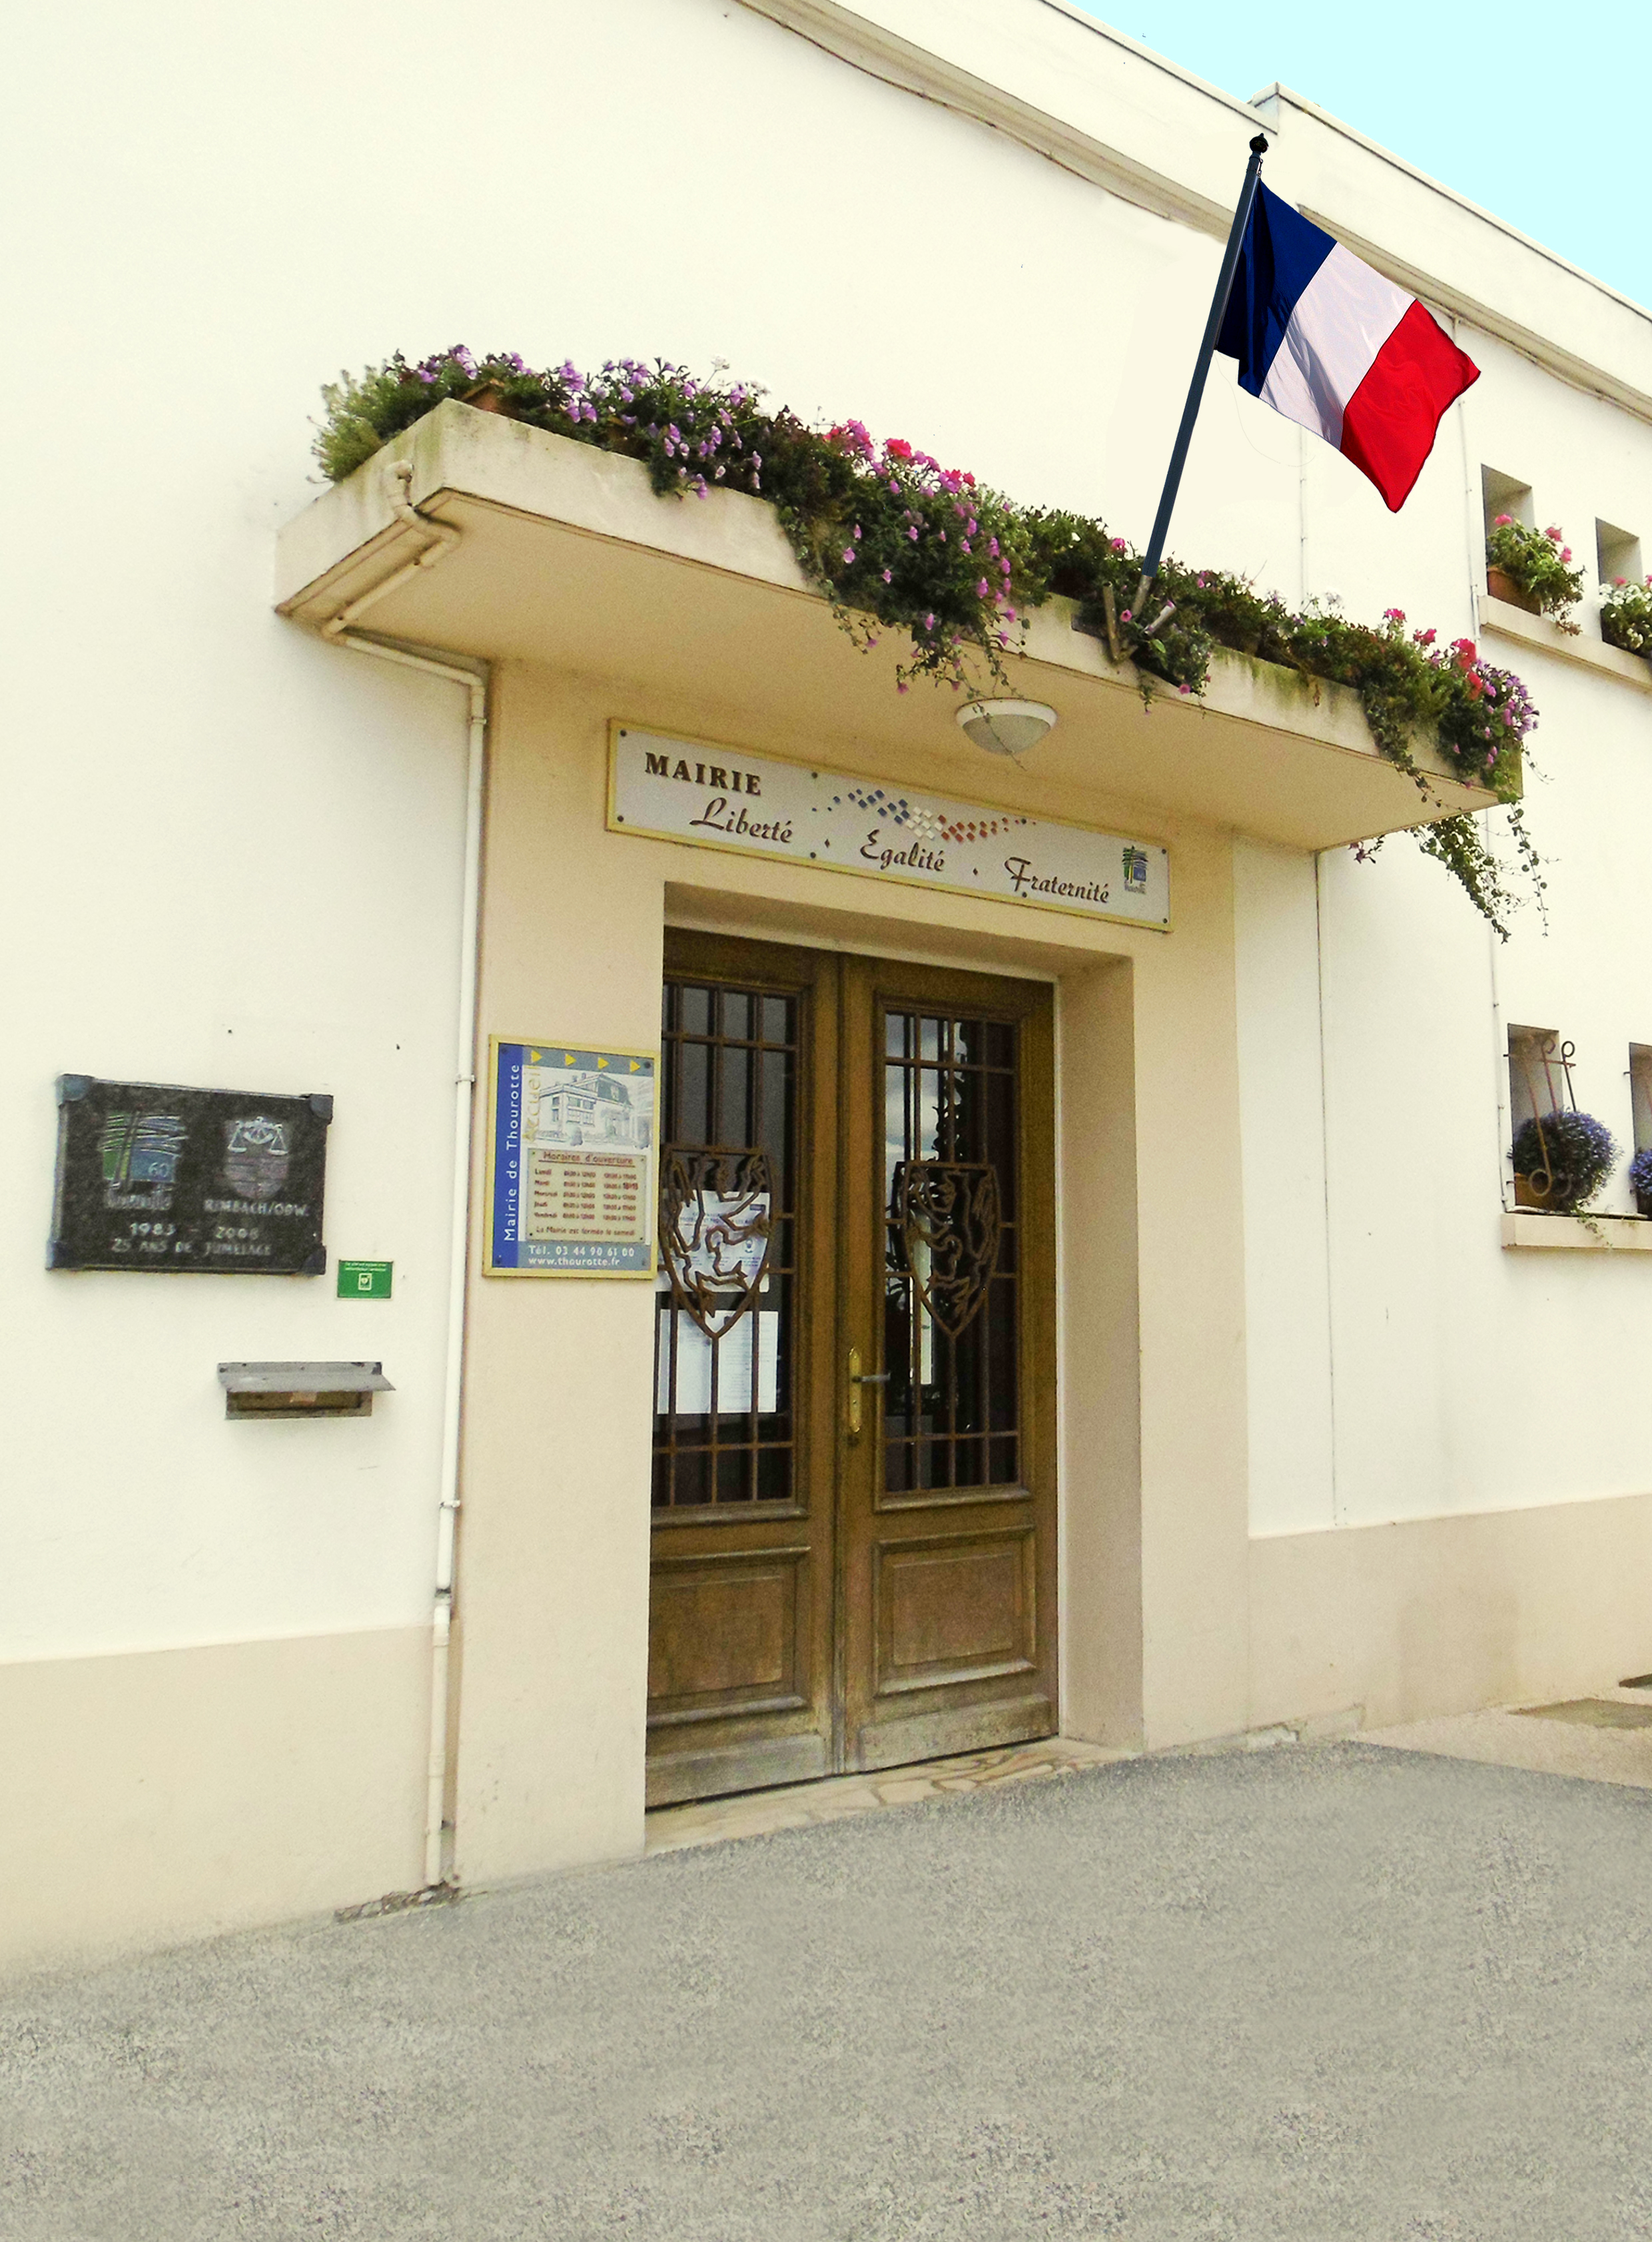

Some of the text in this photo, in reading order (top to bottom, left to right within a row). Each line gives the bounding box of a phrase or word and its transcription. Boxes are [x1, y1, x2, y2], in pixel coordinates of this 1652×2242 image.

[645, 752, 761, 796] MAIRIE
[689, 797, 1109, 903] Liberté Egalité Fraternité
[504, 1064, 520, 1241] Mairie de Thourotte
[175, 1241, 193, 1254] DE
[528, 1246, 635, 1257] Tél. 03 44 90 61 00
[528, 1256, 620, 1266] www.thourotte.fr
